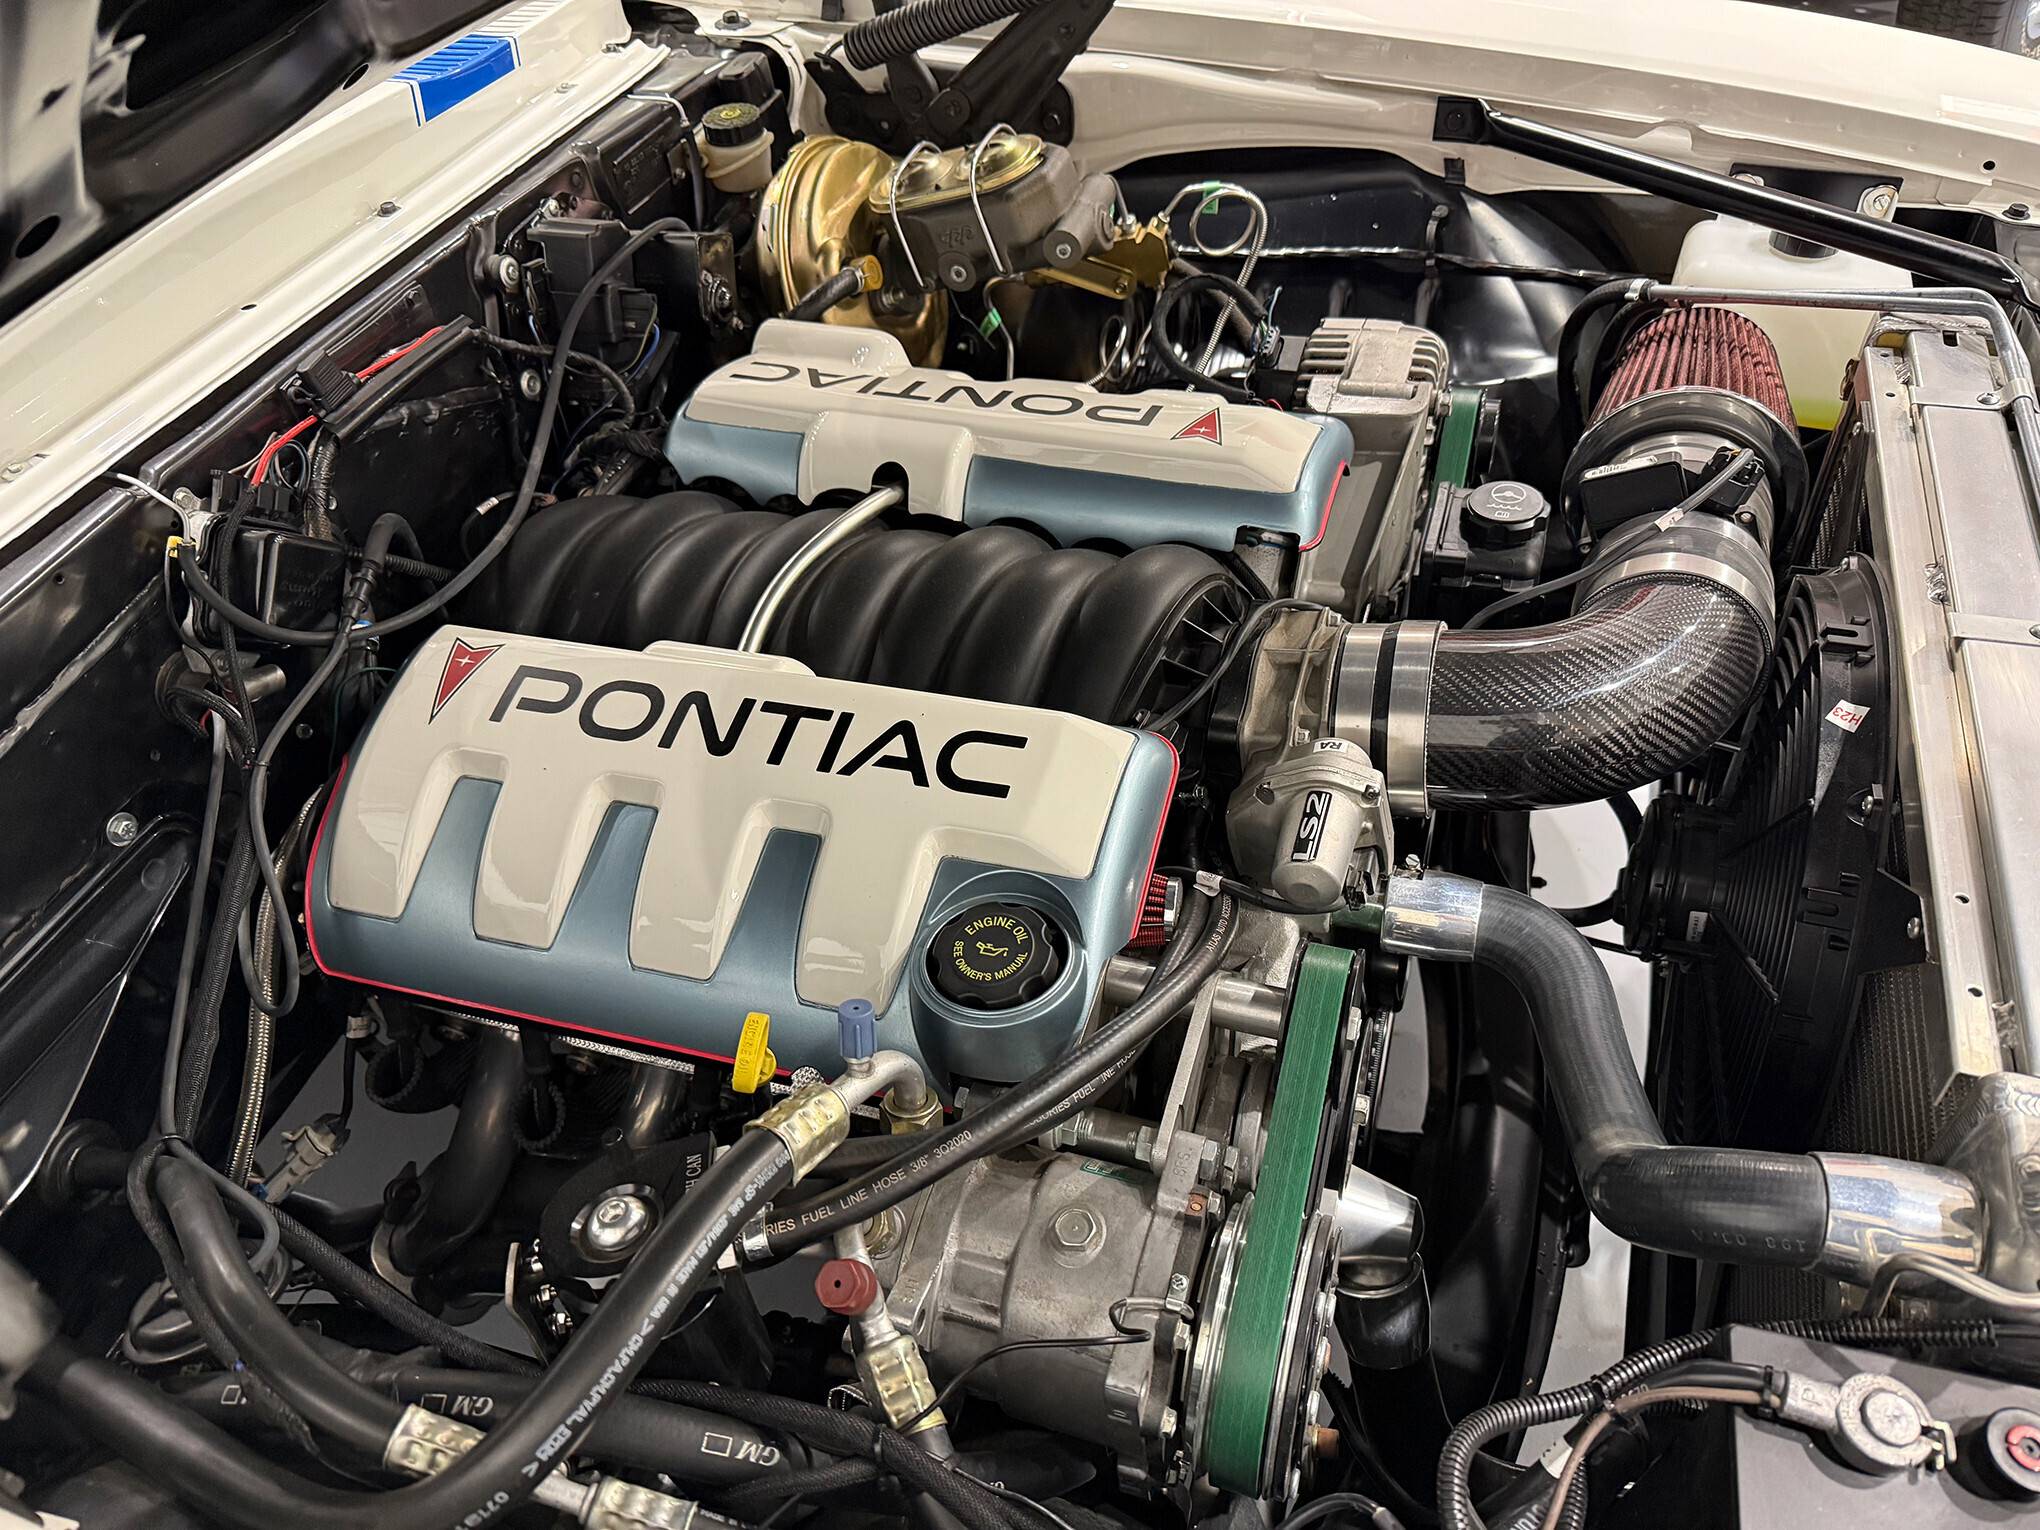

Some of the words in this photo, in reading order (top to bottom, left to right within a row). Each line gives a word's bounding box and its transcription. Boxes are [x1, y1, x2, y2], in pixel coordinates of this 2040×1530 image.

[729, 361, 1164, 426] PONTIAC
[1832, 706, 1863, 726] H23
[489, 665, 1028, 798] PONTIAC
[1320, 741, 1343, 750] RA
[1293, 792, 1327, 860] LS2
[964, 916, 1016, 936] ENGINE
[1012, 926, 1029, 945] OIL
[1205, 933, 1222, 952] ATLAS
[1215, 919, 1228, 935] AUTO
[953, 940, 965, 958] SEE
[955, 958, 992, 982] OWNER'S
[994, 952, 1028, 980] MANUAL
[1073, 1083, 1096, 1103] FUEL
[685, 1153, 702, 1177] CAN
[801, 1204, 835, 1226] FUEL
[840, 1188, 869, 1210] LINE
[872, 1168, 906, 1194] HOSE
[450, 1394, 494, 1416] GM
[734, 1440, 781, 1467] GM
